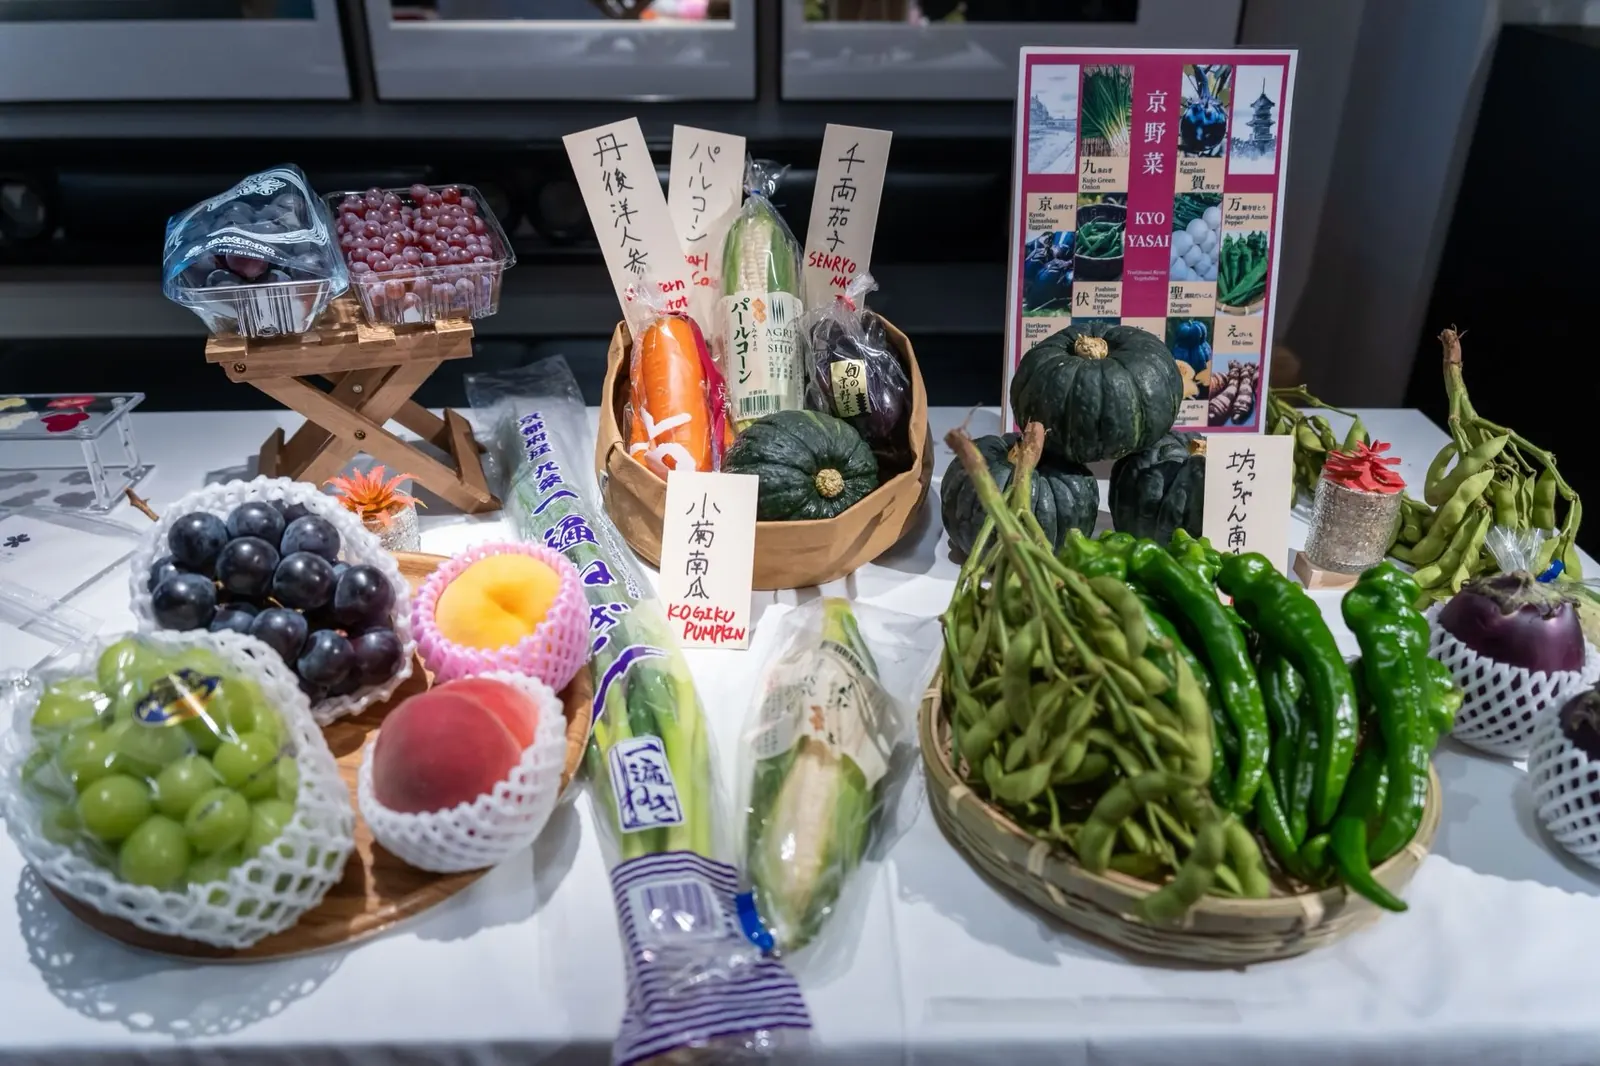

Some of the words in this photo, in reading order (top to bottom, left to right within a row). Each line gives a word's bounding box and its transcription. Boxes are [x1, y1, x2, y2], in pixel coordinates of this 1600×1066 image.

[1142, 89, 1168, 175] 京野菜
[686, 142, 720, 242] パールコーン
[1082, 177, 1097, 185] Kujo
[593, 133, 649, 279] 丹後洋人参
[826, 142, 865, 252] 千両茄子
[1134, 211, 1165, 225] KYO
[1128, 234, 1170, 248] YASAI
[808, 251, 857, 274] SENRYO
[1076, 291, 1090, 306] 伏
[731, 296, 753, 384] パールコーン
[765, 327, 793, 339] AGRI
[768, 344, 794, 355] SHIP
[1226, 448, 1256, 555] 坊っちゃん南
[684, 493, 721, 599] 小菊南瓜
[667, 603, 736, 623] KOGIKU
[683, 621, 746, 644] PUMPKIN
